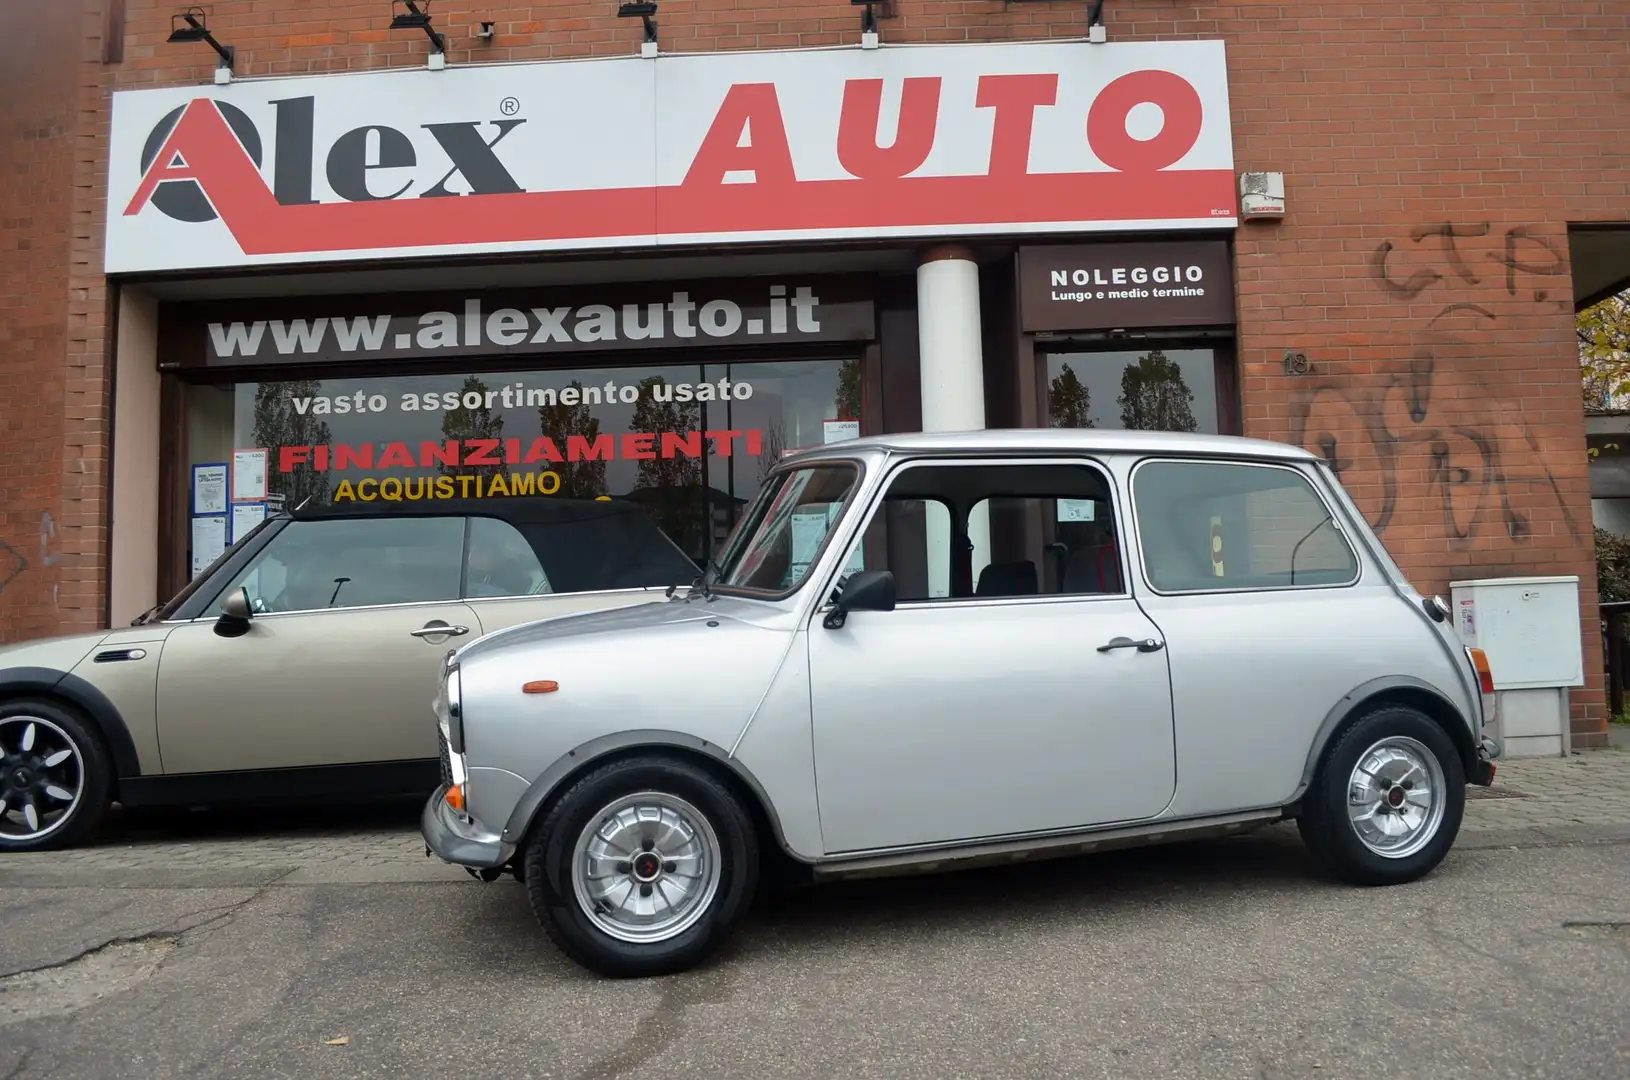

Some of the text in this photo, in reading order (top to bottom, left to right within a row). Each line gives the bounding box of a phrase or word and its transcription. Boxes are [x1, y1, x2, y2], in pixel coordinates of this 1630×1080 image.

[680, 69, 1203, 187] AUTO
[1051, 266, 1203, 287] NOLEGGIO
[1051, 286, 1205, 303] Lungo e medio termine
[207, 286, 821, 358] www.alexauto.it
[292, 377, 753, 415] vasto assortimento usato
[279, 429, 762, 473] FINANZIAMENTI
[334, 471, 561, 503] ACQUISTIAMO
